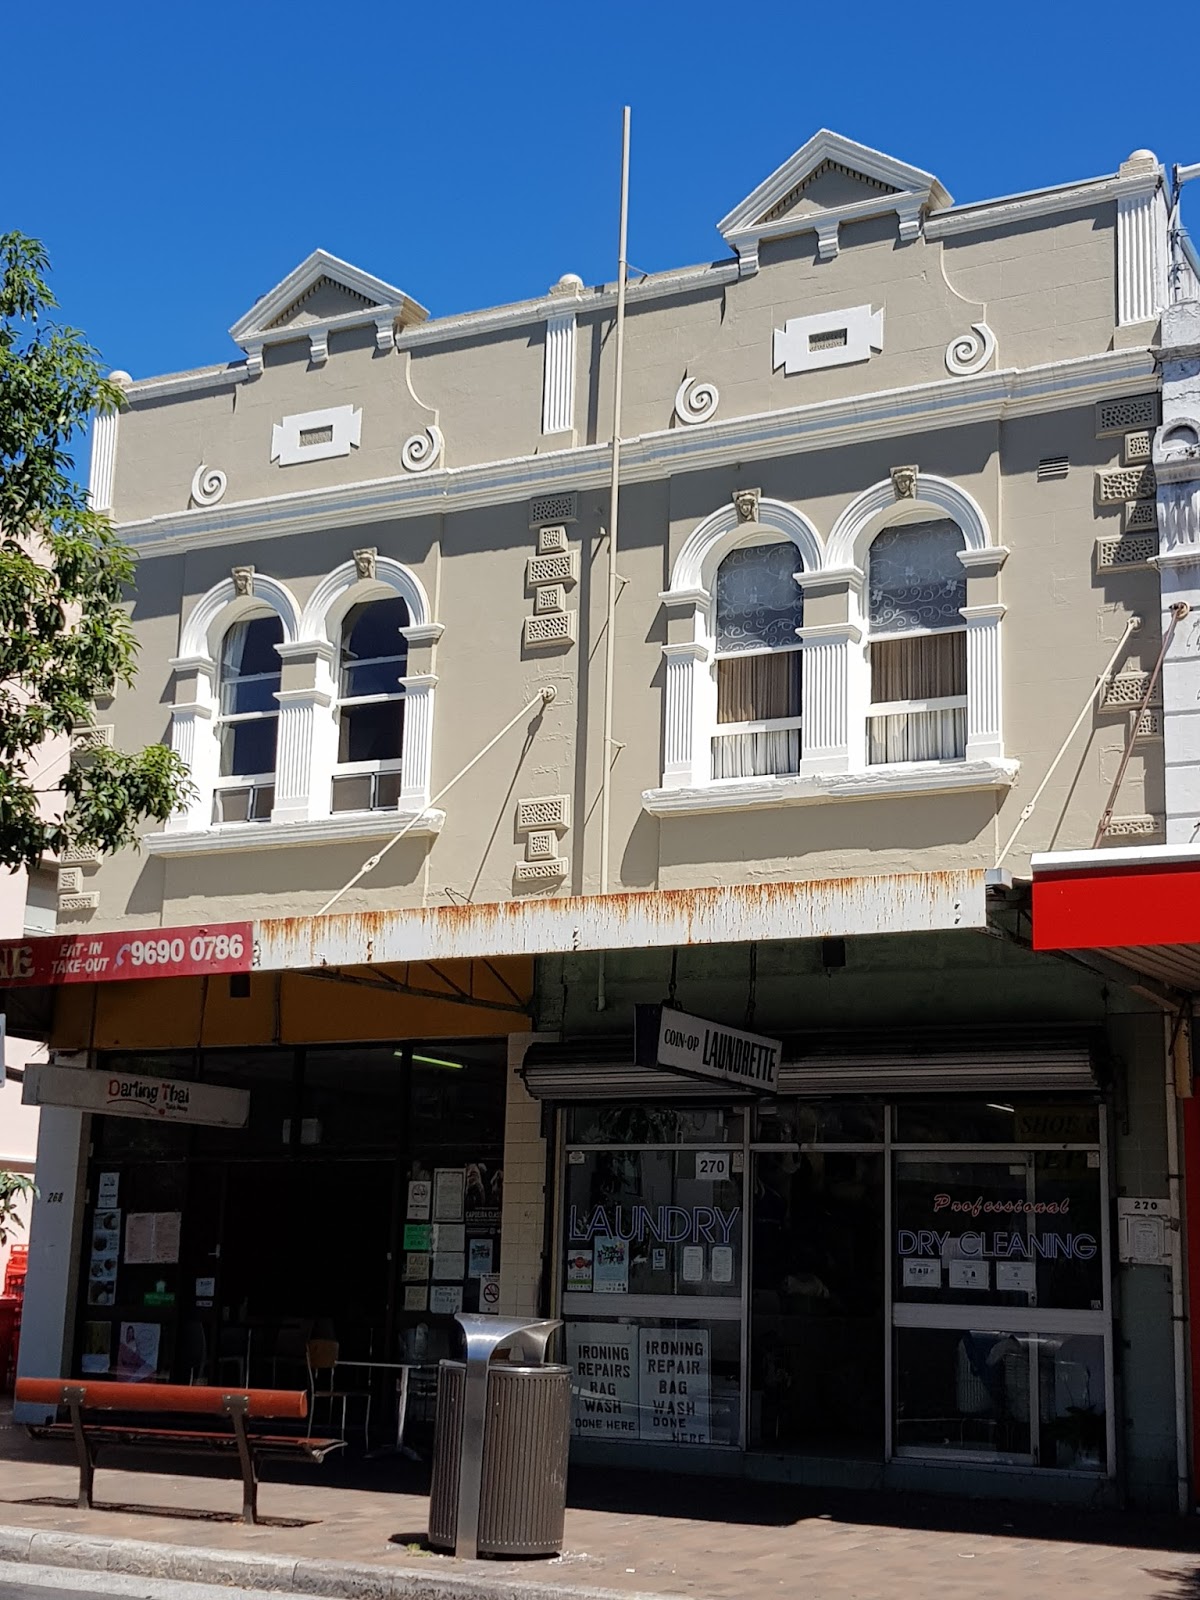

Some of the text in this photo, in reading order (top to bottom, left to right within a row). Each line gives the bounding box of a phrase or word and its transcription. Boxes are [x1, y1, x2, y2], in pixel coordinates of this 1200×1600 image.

[59, 941, 104, 957] EAT-IN
[130, 934, 244, 966] 9690 0786
[51, 957, 110, 974] TAKE-OUT
[702, 1029, 777, 1082] LAUNDRETTE
[108, 1079, 190, 1104] Darling Thai
[700, 1160, 724, 1173] 270
[933, 1193, 1070, 1217] Professional
[1134, 1201, 1158, 1210] 270
[569, 1204, 741, 1244] LAUNDRY
[898, 1229, 1098, 1260] DRY CLEANING
[578, 1345, 629, 1361] IRONING
[646, 1341, 703, 1356] IRONING
[578, 1362, 630, 1378] REPAIRS
[648, 1359, 700, 1375] REPAIR
[659, 1380, 687, 1395] BAG
[584, 1399, 622, 1414] WASH
[653, 1399, 695, 1416] WASH
[575, 1418, 635, 1431] DONE HERE
[653, 1416, 686, 1428] DONE
[672, 1432, 706, 1443] HERE
